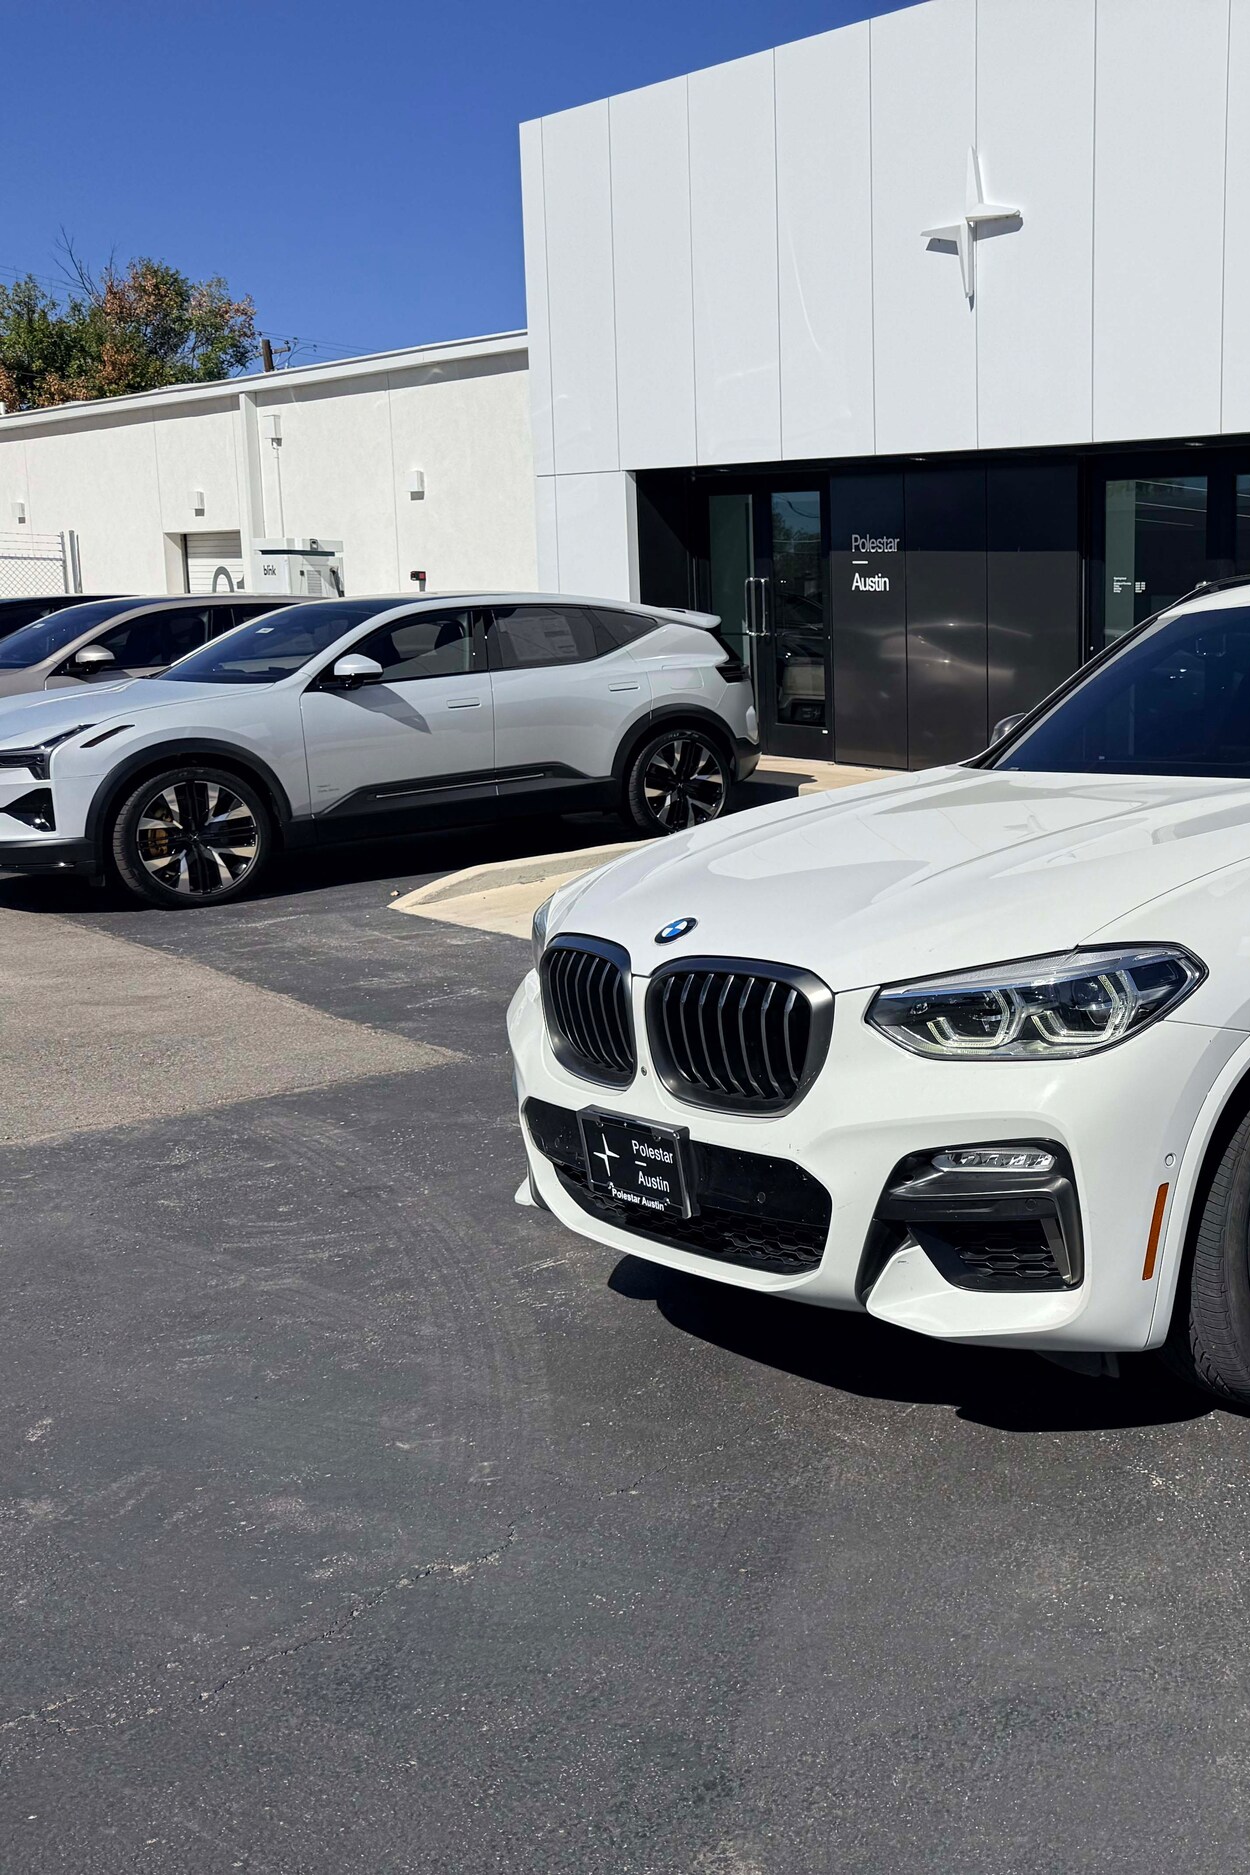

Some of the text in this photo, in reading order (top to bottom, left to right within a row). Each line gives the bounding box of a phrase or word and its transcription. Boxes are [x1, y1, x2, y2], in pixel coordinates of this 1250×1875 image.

[851, 533, 900, 552] Polestar
[851, 572, 890, 592] Austin
[631, 1140, 674, 1164] Polestar
[638, 1171, 670, 1193] Austin
[612, 1188, 665, 1211] Polestar Austin
